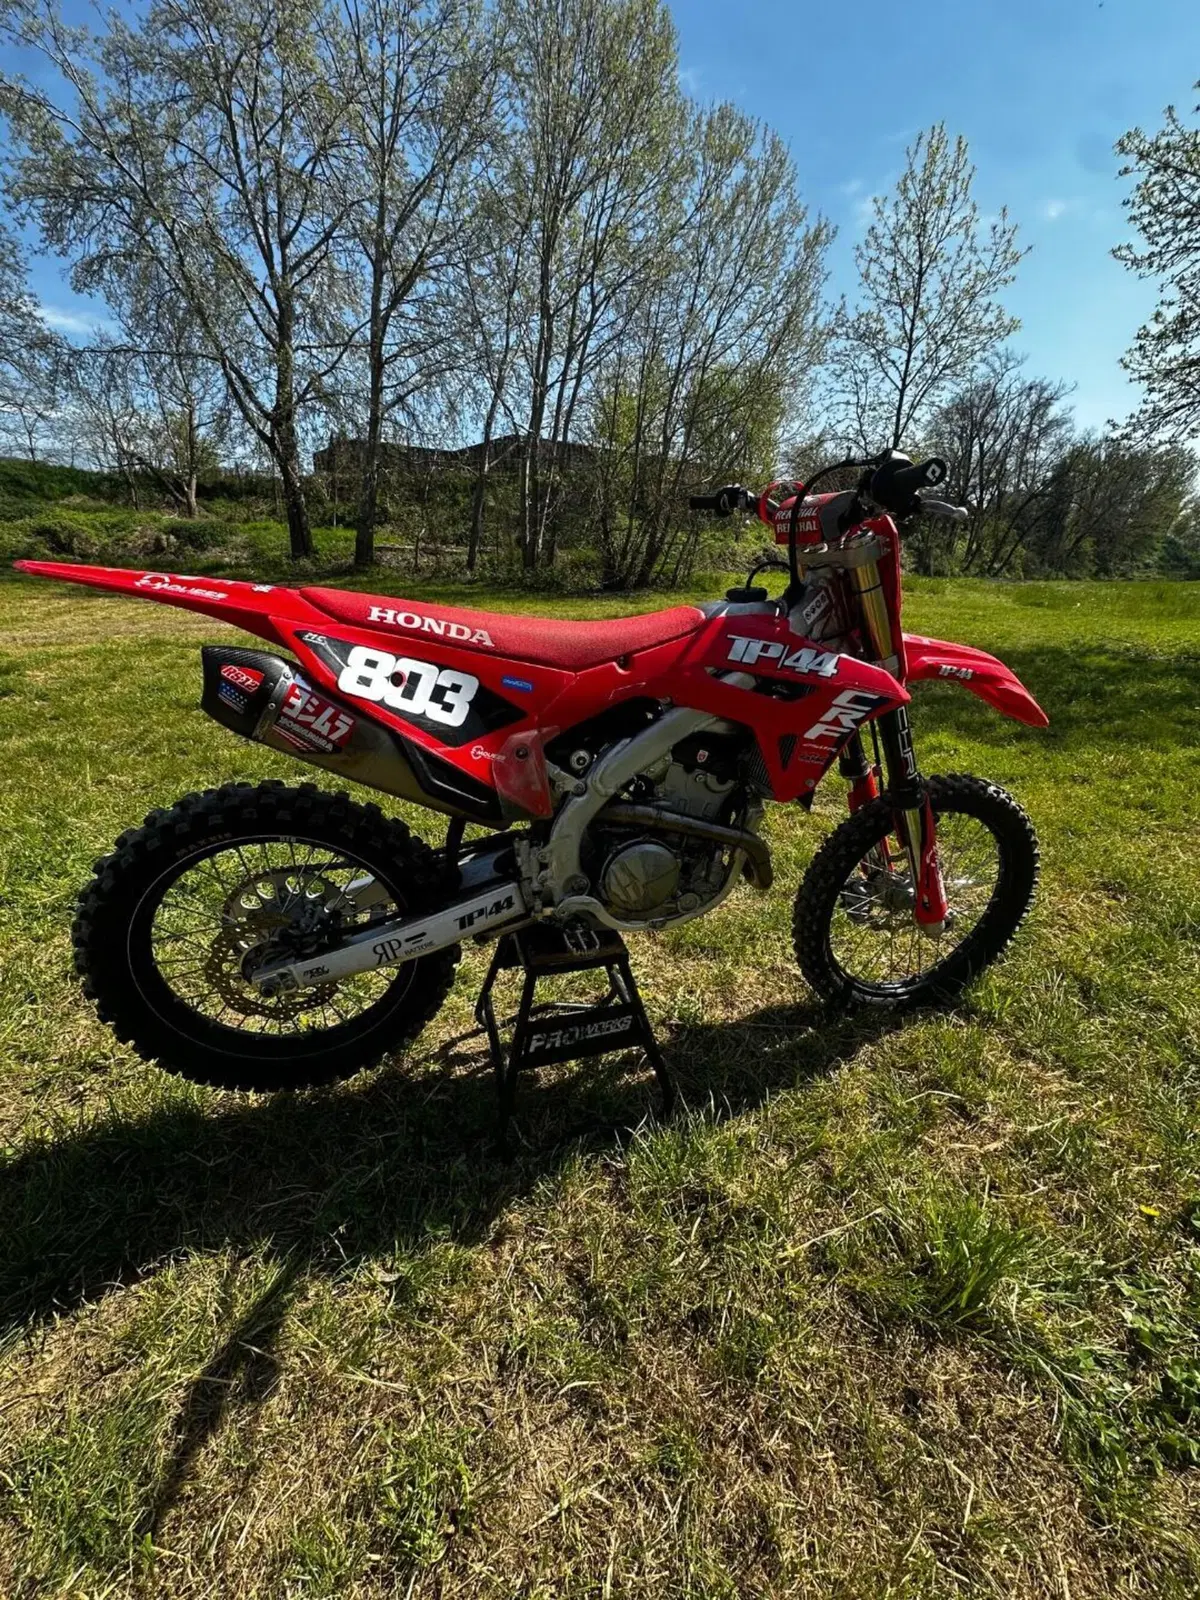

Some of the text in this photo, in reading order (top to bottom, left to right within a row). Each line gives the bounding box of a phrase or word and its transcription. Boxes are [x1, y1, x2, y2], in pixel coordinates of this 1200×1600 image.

[774, 507, 819, 520] RENHAL
[367, 605, 496, 648] HONDA
[337, 645, 480, 728] 803
[803, 689, 880, 740] CRF
